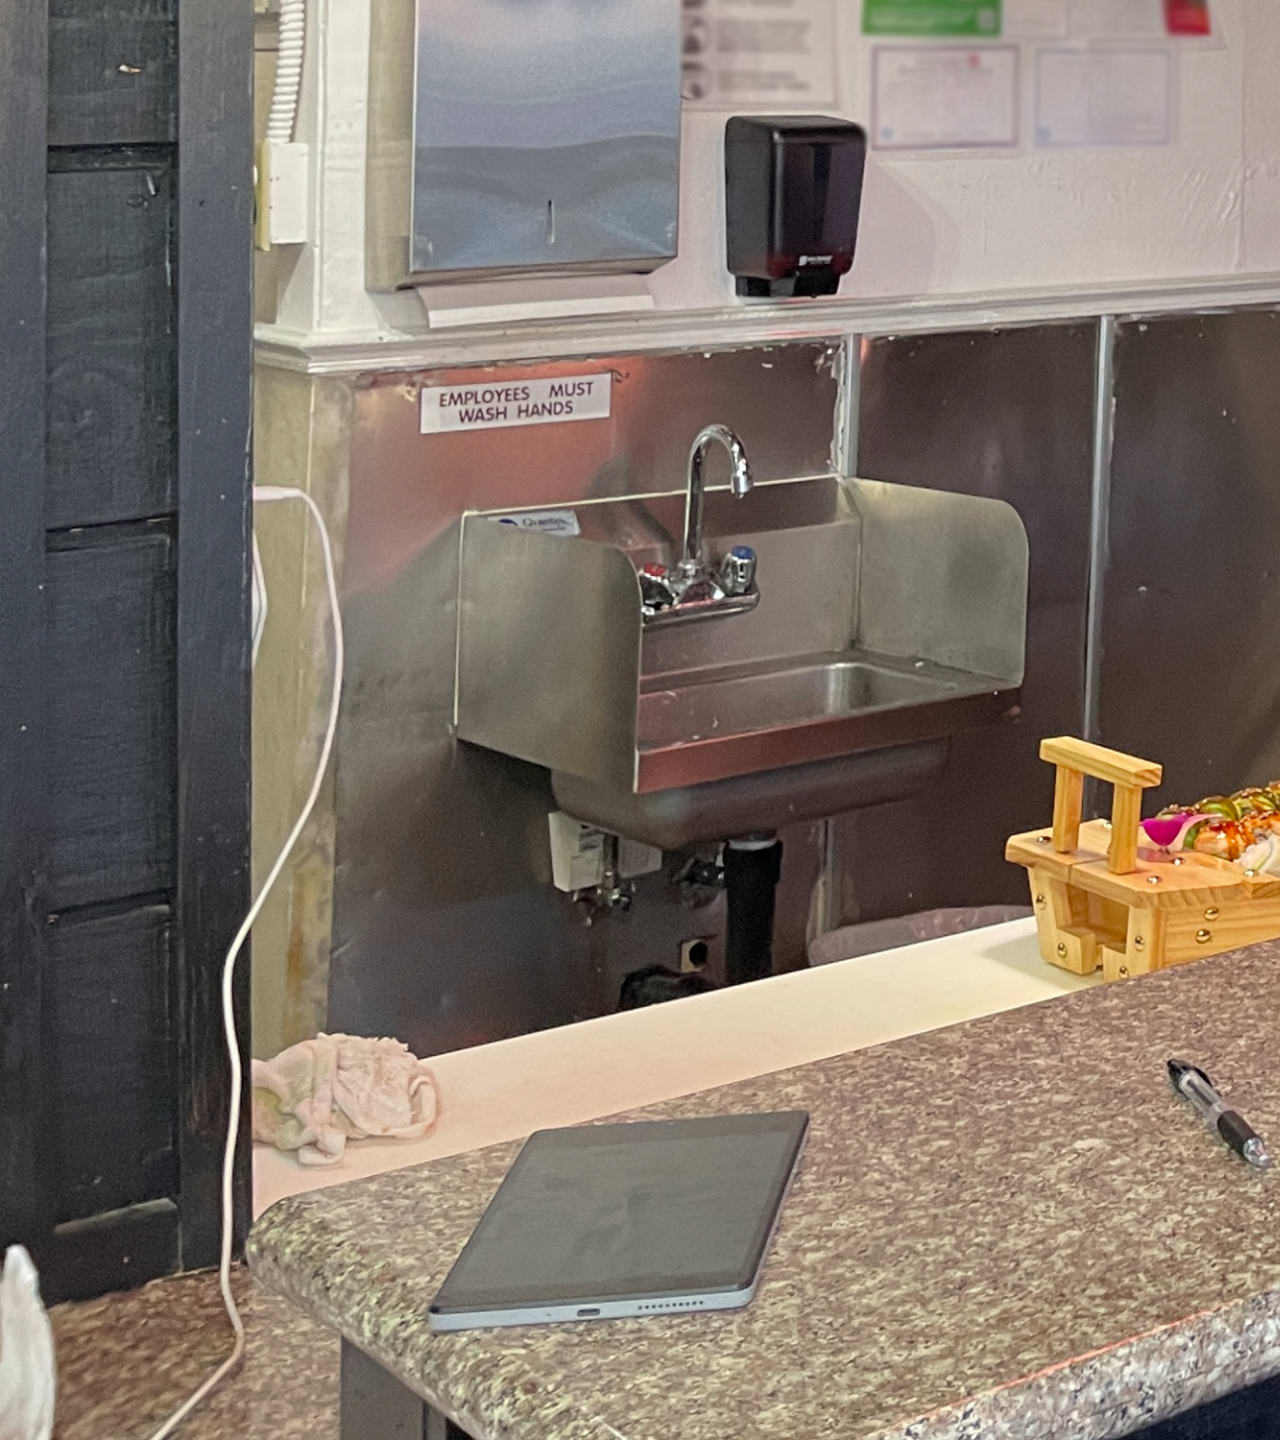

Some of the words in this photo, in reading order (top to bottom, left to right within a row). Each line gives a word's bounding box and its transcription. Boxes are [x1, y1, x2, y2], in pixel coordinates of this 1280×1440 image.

[438, 386, 530, 408] EMPLOYEES
[548, 381, 595, 399] MUST
[458, 406, 508, 424] WASH
[517, 400, 574, 419] HANDS
